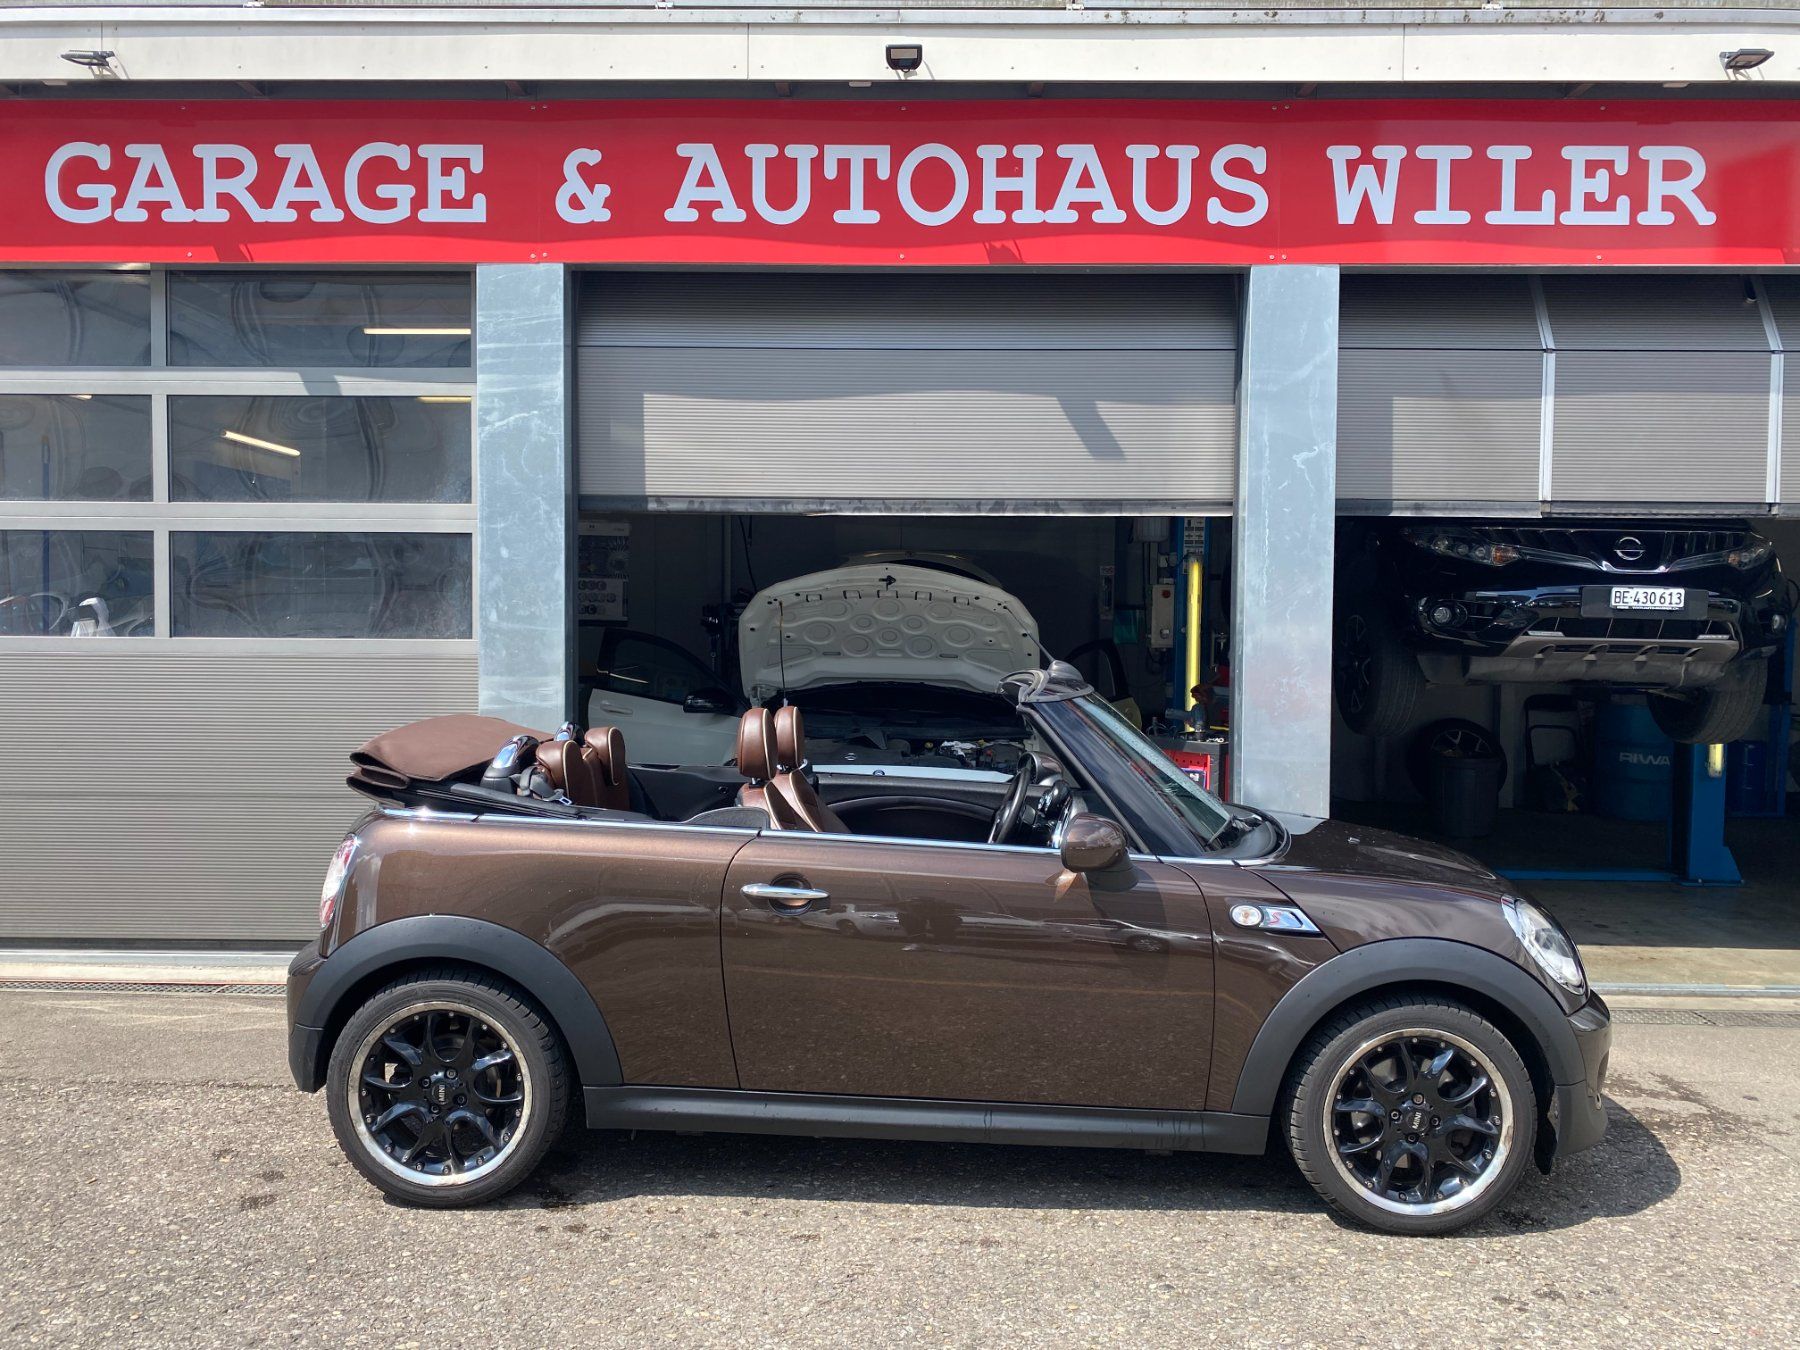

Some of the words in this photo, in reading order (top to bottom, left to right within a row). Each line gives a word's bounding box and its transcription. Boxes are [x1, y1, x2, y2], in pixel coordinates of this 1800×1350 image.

[44, 141, 487, 224] GARAGE
[555, 148, 612, 224] &
[664, 143, 1270, 227] AUTOHAUS
[1326, 145, 1717, 226] WILER
[1619, 752, 1670, 766] RIWA
[438, 1084, 446, 1102] MINI
[1412, 1111, 1422, 1129] MINI
